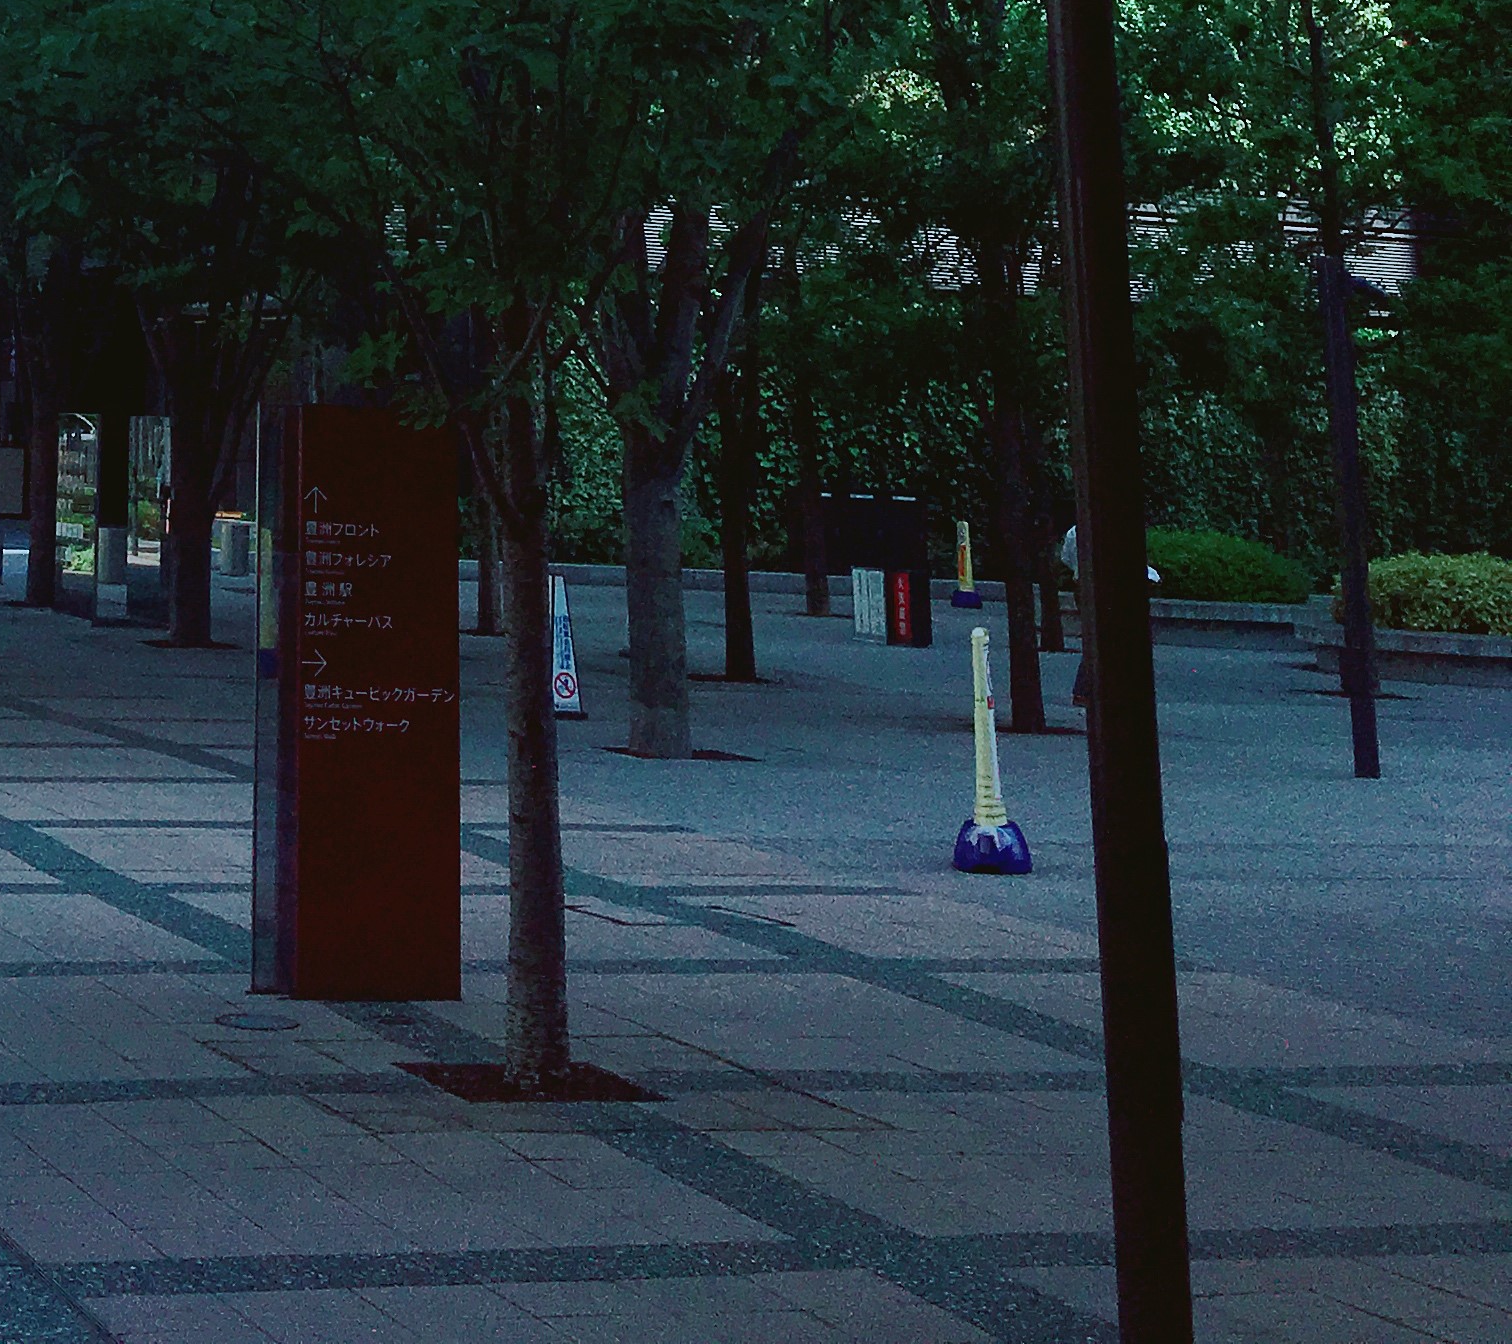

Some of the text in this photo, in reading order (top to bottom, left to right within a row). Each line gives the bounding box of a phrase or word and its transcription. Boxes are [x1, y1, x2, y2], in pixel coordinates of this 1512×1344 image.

[305, 520, 379, 537] 豊洲フロント
[305, 550, 392, 567] 豊洲フォレシア
[304, 715, 410, 732] サンセットウォーク
